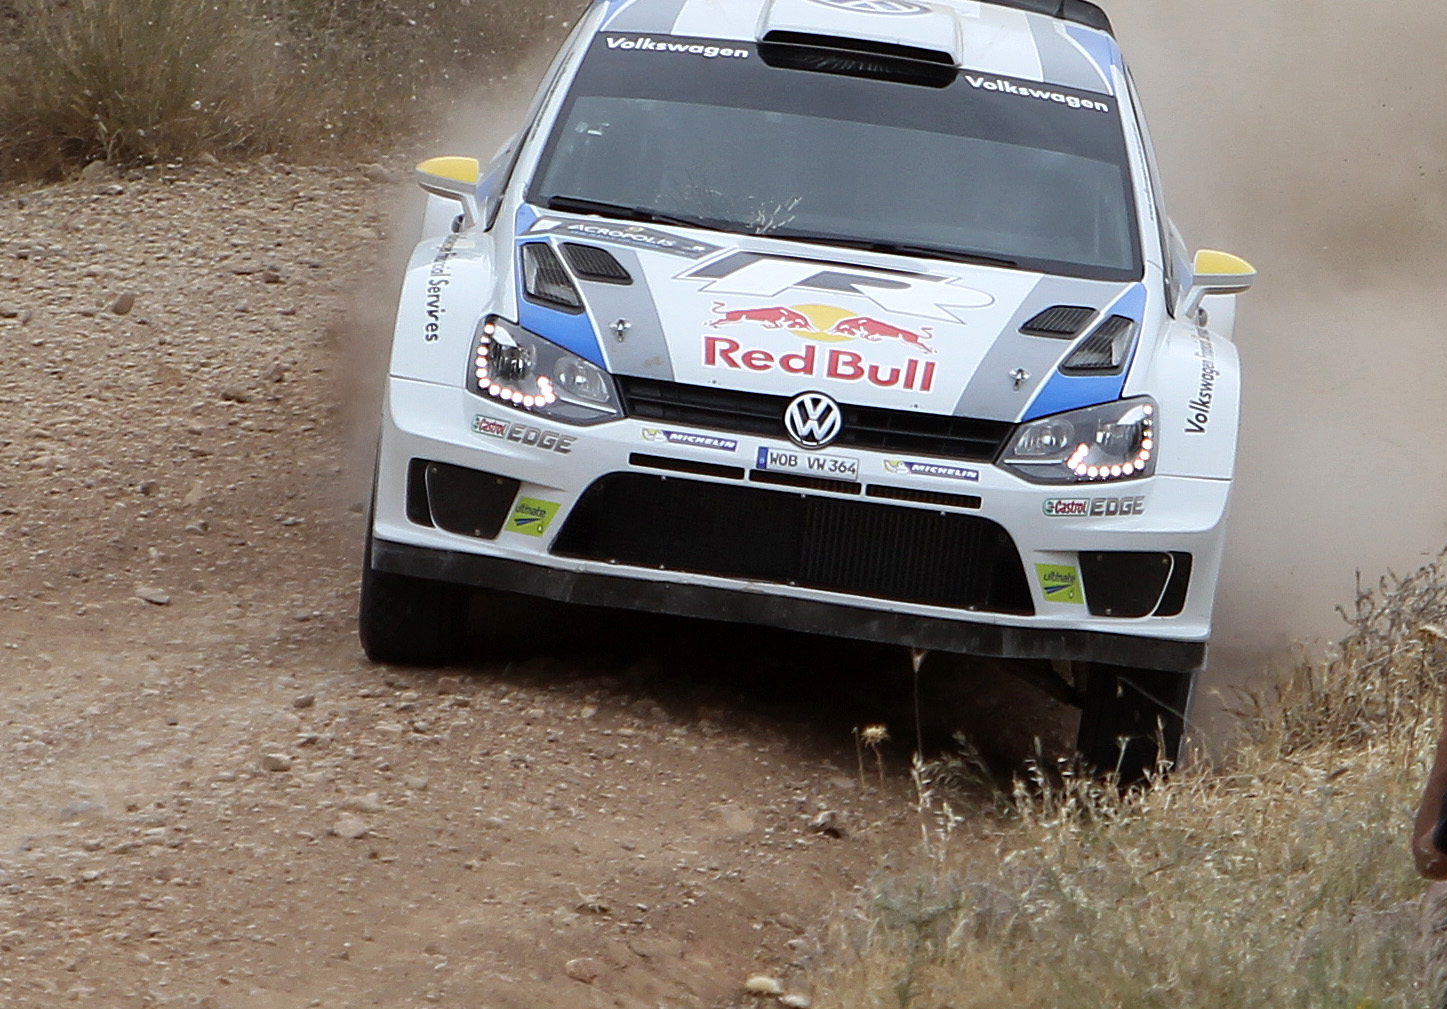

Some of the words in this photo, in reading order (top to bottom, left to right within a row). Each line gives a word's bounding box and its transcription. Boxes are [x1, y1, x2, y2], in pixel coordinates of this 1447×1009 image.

[605, 36, 750, 59] Volkswagen
[964, 75, 1110, 113] Volkswagen
[567, 224, 677, 247] ACROPOLIS
[703, 336, 816, 375] Red
[827, 349, 937, 392] Bull
[478, 418, 508, 435] Castrol
[507, 422, 578, 454] EDGE
[668, 432, 736, 449] MICHELIN
[769, 452, 798, 467] WOB
[807, 456, 826, 471] VW
[828, 459, 857, 474] 364
[911, 464, 978, 479] MICHELIN
[1055, 500, 1087, 514] Castrol
[1090, 495, 1145, 516] EDGE
